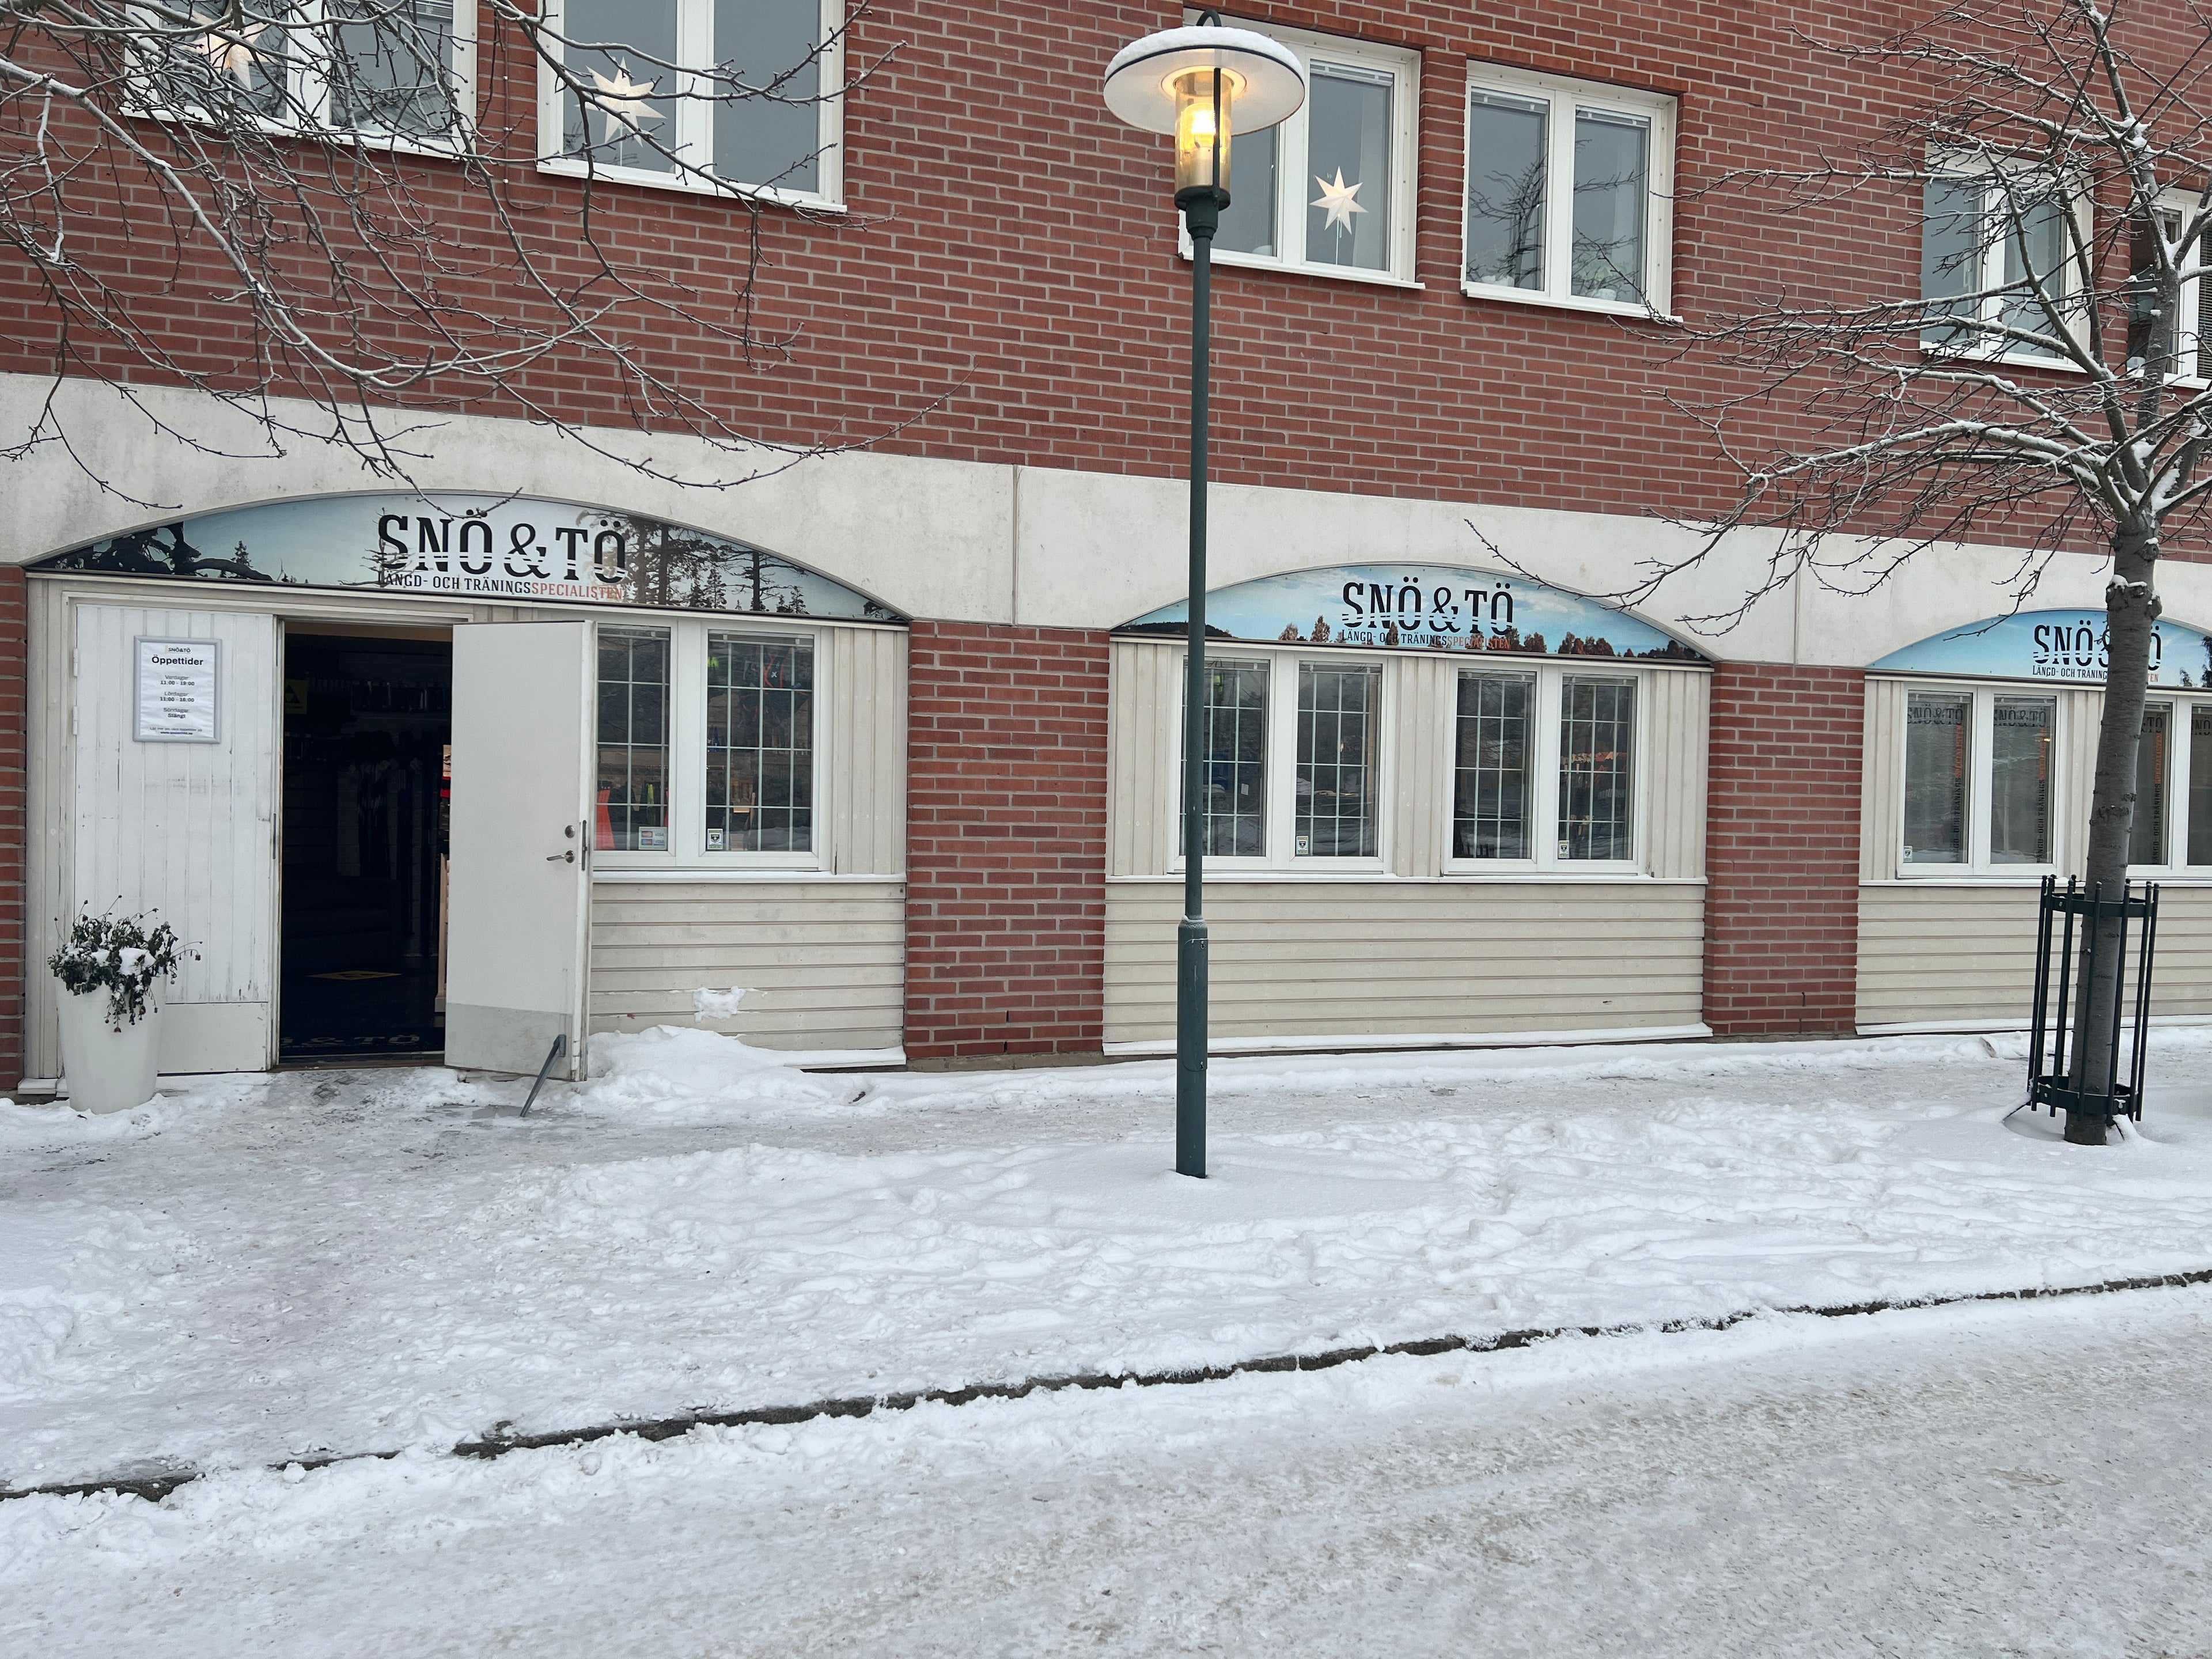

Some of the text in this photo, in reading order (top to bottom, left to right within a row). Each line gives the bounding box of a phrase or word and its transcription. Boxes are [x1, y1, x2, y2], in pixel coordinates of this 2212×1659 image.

[433, 575, 460, 589] OCH
[1380, 634, 1399, 643] OCH
[151, 654, 204, 665] Öppettider
[2061, 668, 2075, 677] OCH
